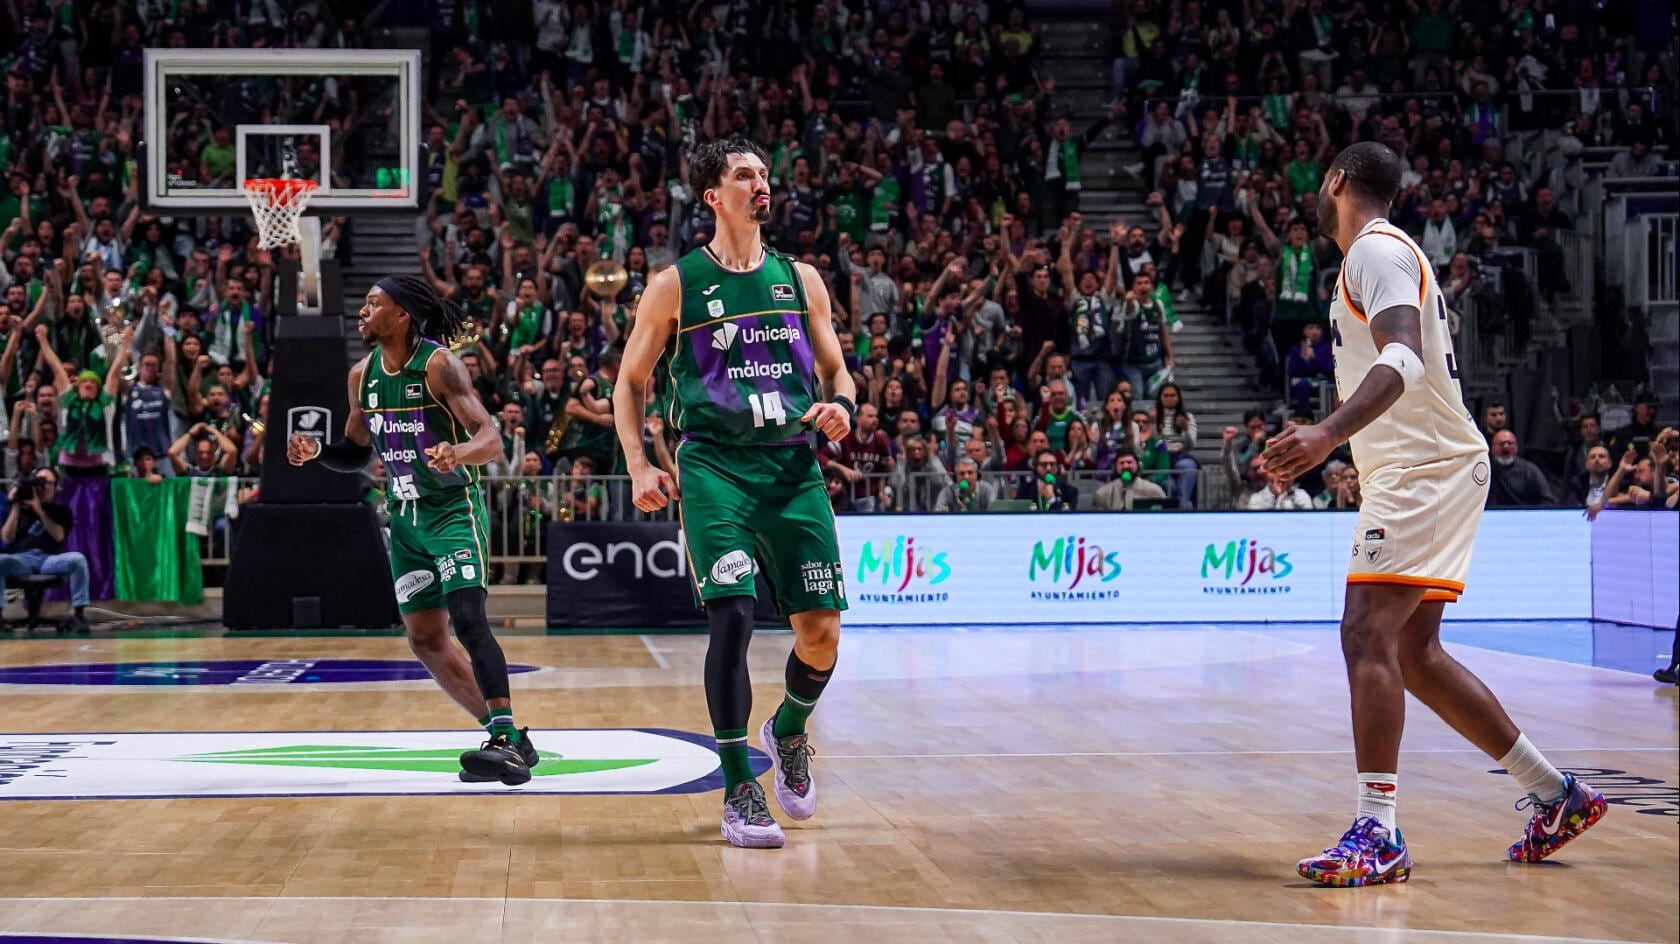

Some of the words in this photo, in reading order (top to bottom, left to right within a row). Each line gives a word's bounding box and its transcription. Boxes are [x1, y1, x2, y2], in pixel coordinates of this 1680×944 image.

[742, 324, 800, 344] Unicaja
[748, 391, 786, 428] 14
[384, 419, 425, 437] Unicaja
[801, 560, 822, 570] sabor
[857, 535, 951, 592] Mijas
[1028, 535, 1122, 590] Mijas
[1201, 538, 1293, 585] Mijas
[808, 562, 833, 580] má
[804, 578, 835, 595] laga
[1031, 590, 1120, 600] AYUNTAMIENTO
[1203, 585, 1291, 595] AYUNTAMIENTO
[859, 592, 949, 602] AYUNTAMIENTO
